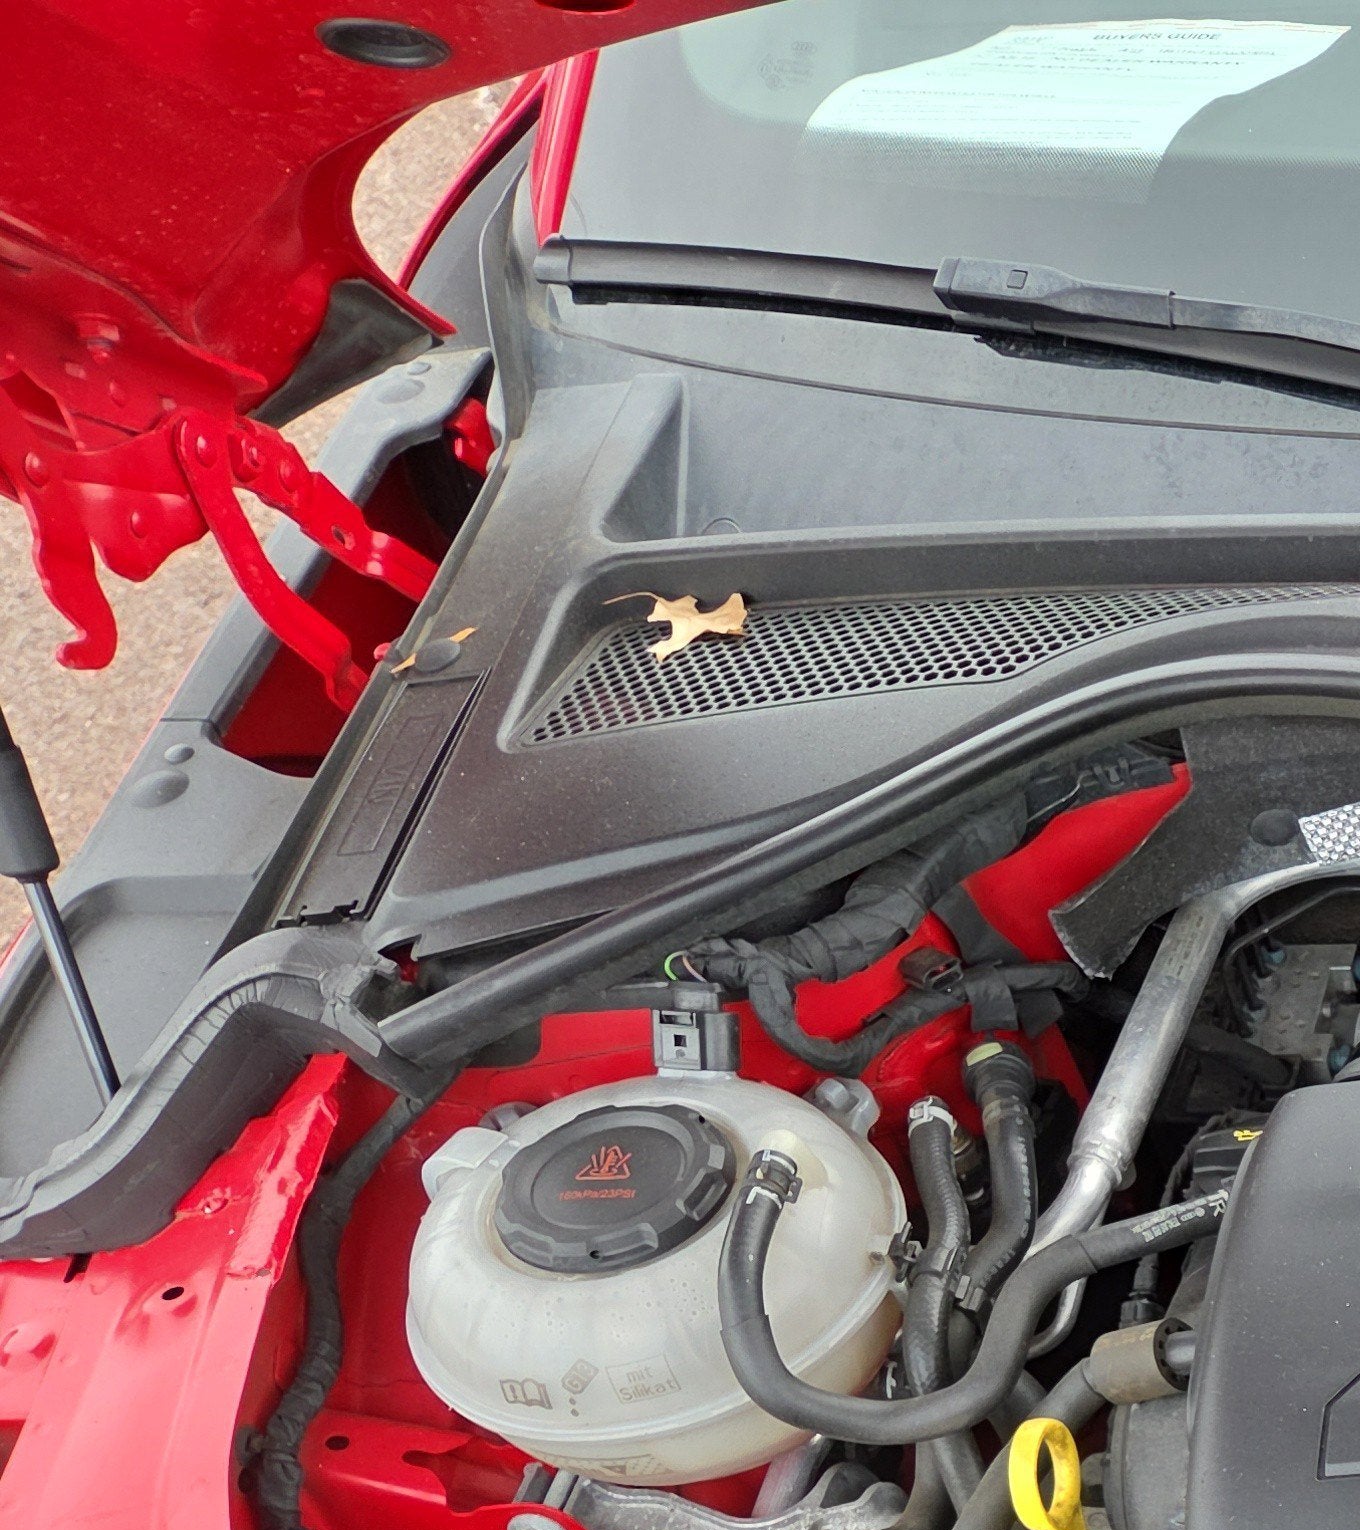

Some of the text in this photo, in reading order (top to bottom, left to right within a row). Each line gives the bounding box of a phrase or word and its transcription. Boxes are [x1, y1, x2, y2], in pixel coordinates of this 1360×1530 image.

[1167, 32, 1222, 40] GUIDE
[626, 1366, 654, 1382] mit
[619, 1379, 678, 1401] Silikat
